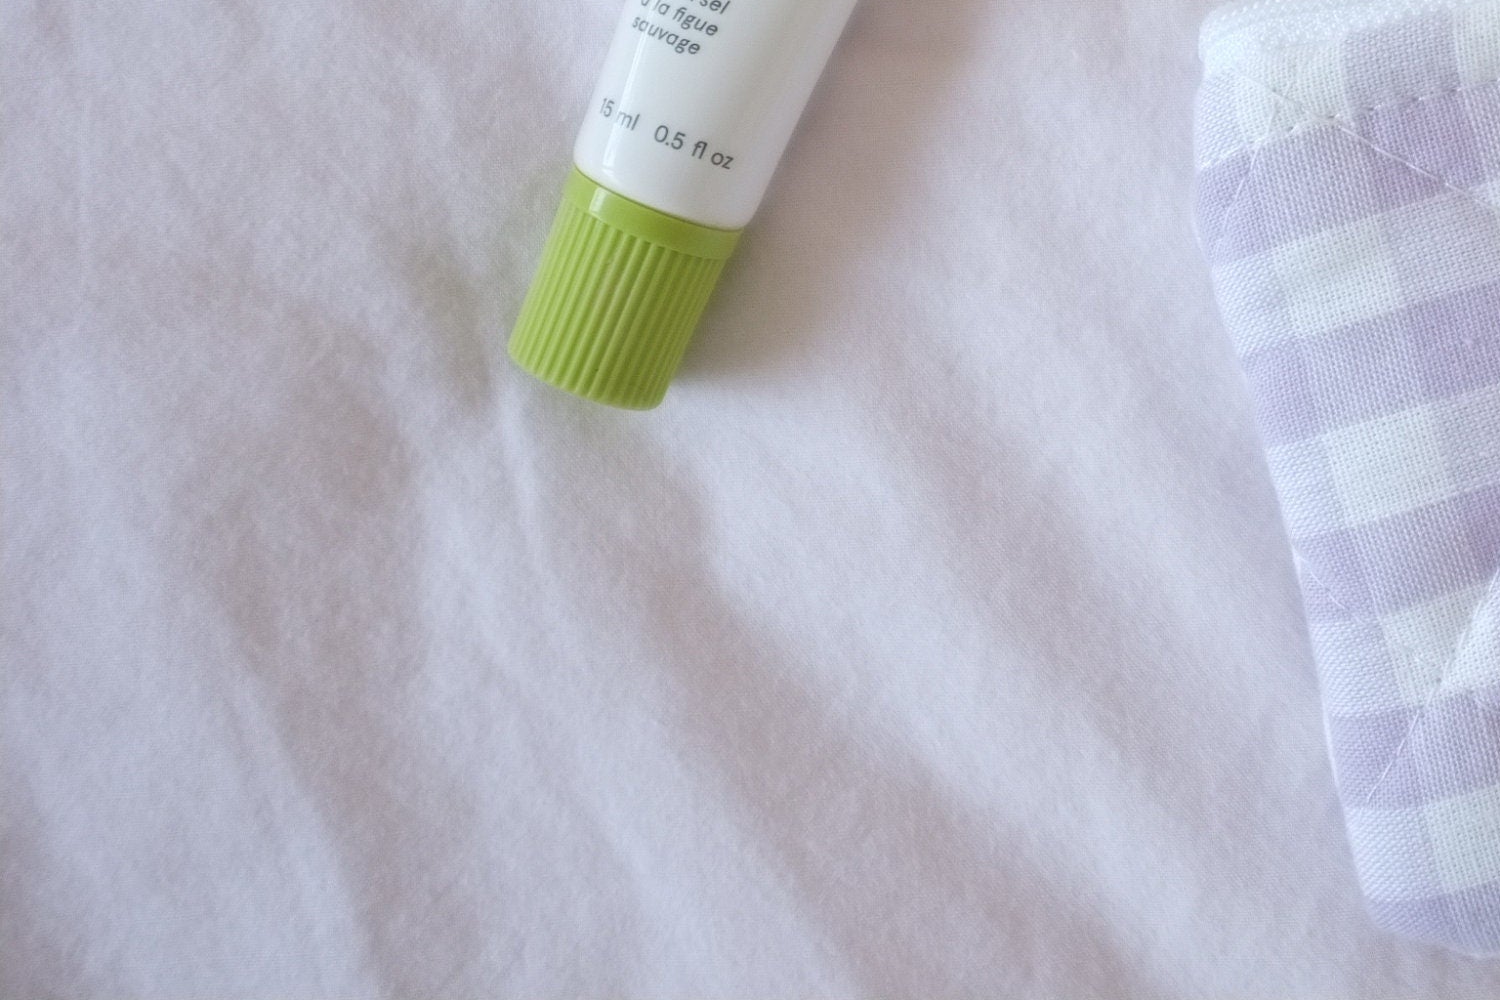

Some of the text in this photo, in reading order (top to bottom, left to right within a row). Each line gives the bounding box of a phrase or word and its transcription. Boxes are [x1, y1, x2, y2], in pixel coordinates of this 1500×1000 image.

[631, 16, 701, 55] sauvage
[672, 6, 719, 36] figue
[599, 98, 735, 170] 15 ml 0.5 fl oz
